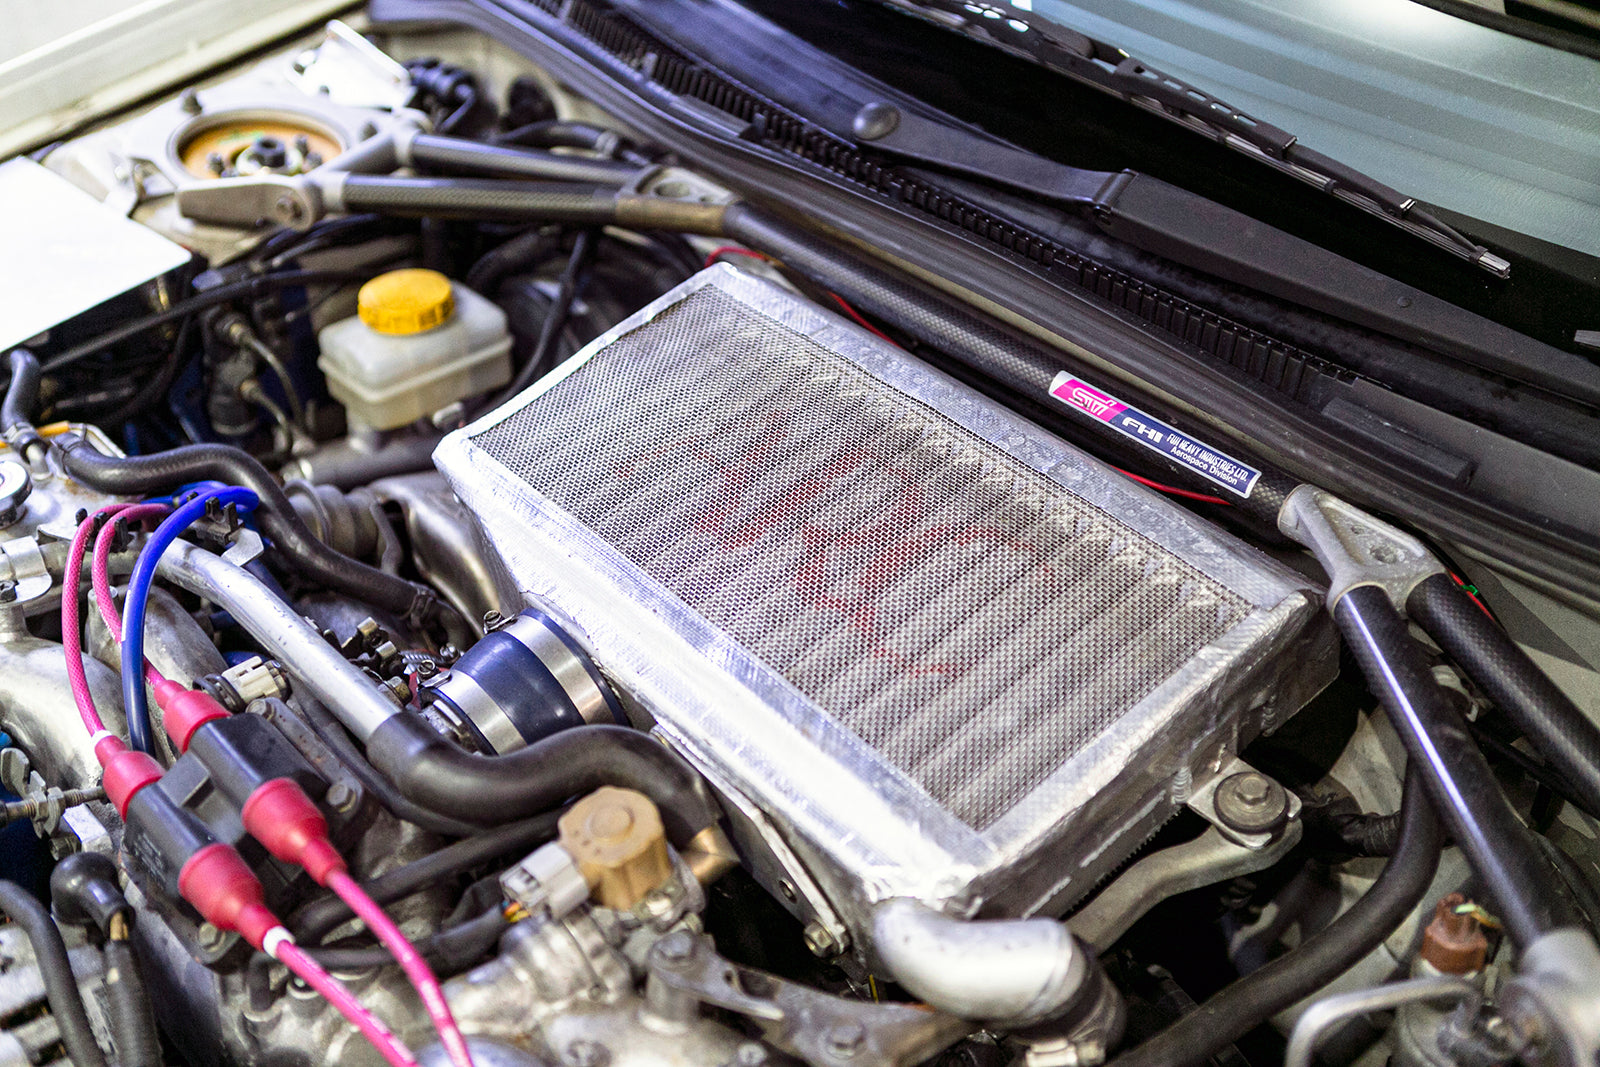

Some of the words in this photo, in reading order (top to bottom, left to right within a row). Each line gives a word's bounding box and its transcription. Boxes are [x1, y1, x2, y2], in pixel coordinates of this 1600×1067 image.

[1122, 417, 1164, 444] FHI
[1167, 433, 1182, 446] FUJI
[1179, 440, 1202, 457] HEAVY
[1199, 449, 1236, 474] INDUSTRIES
[1234, 467, 1249, 482] LTD.
[1170, 446, 1208, 471] Aerospace
[1209, 465, 1238, 486] Division
